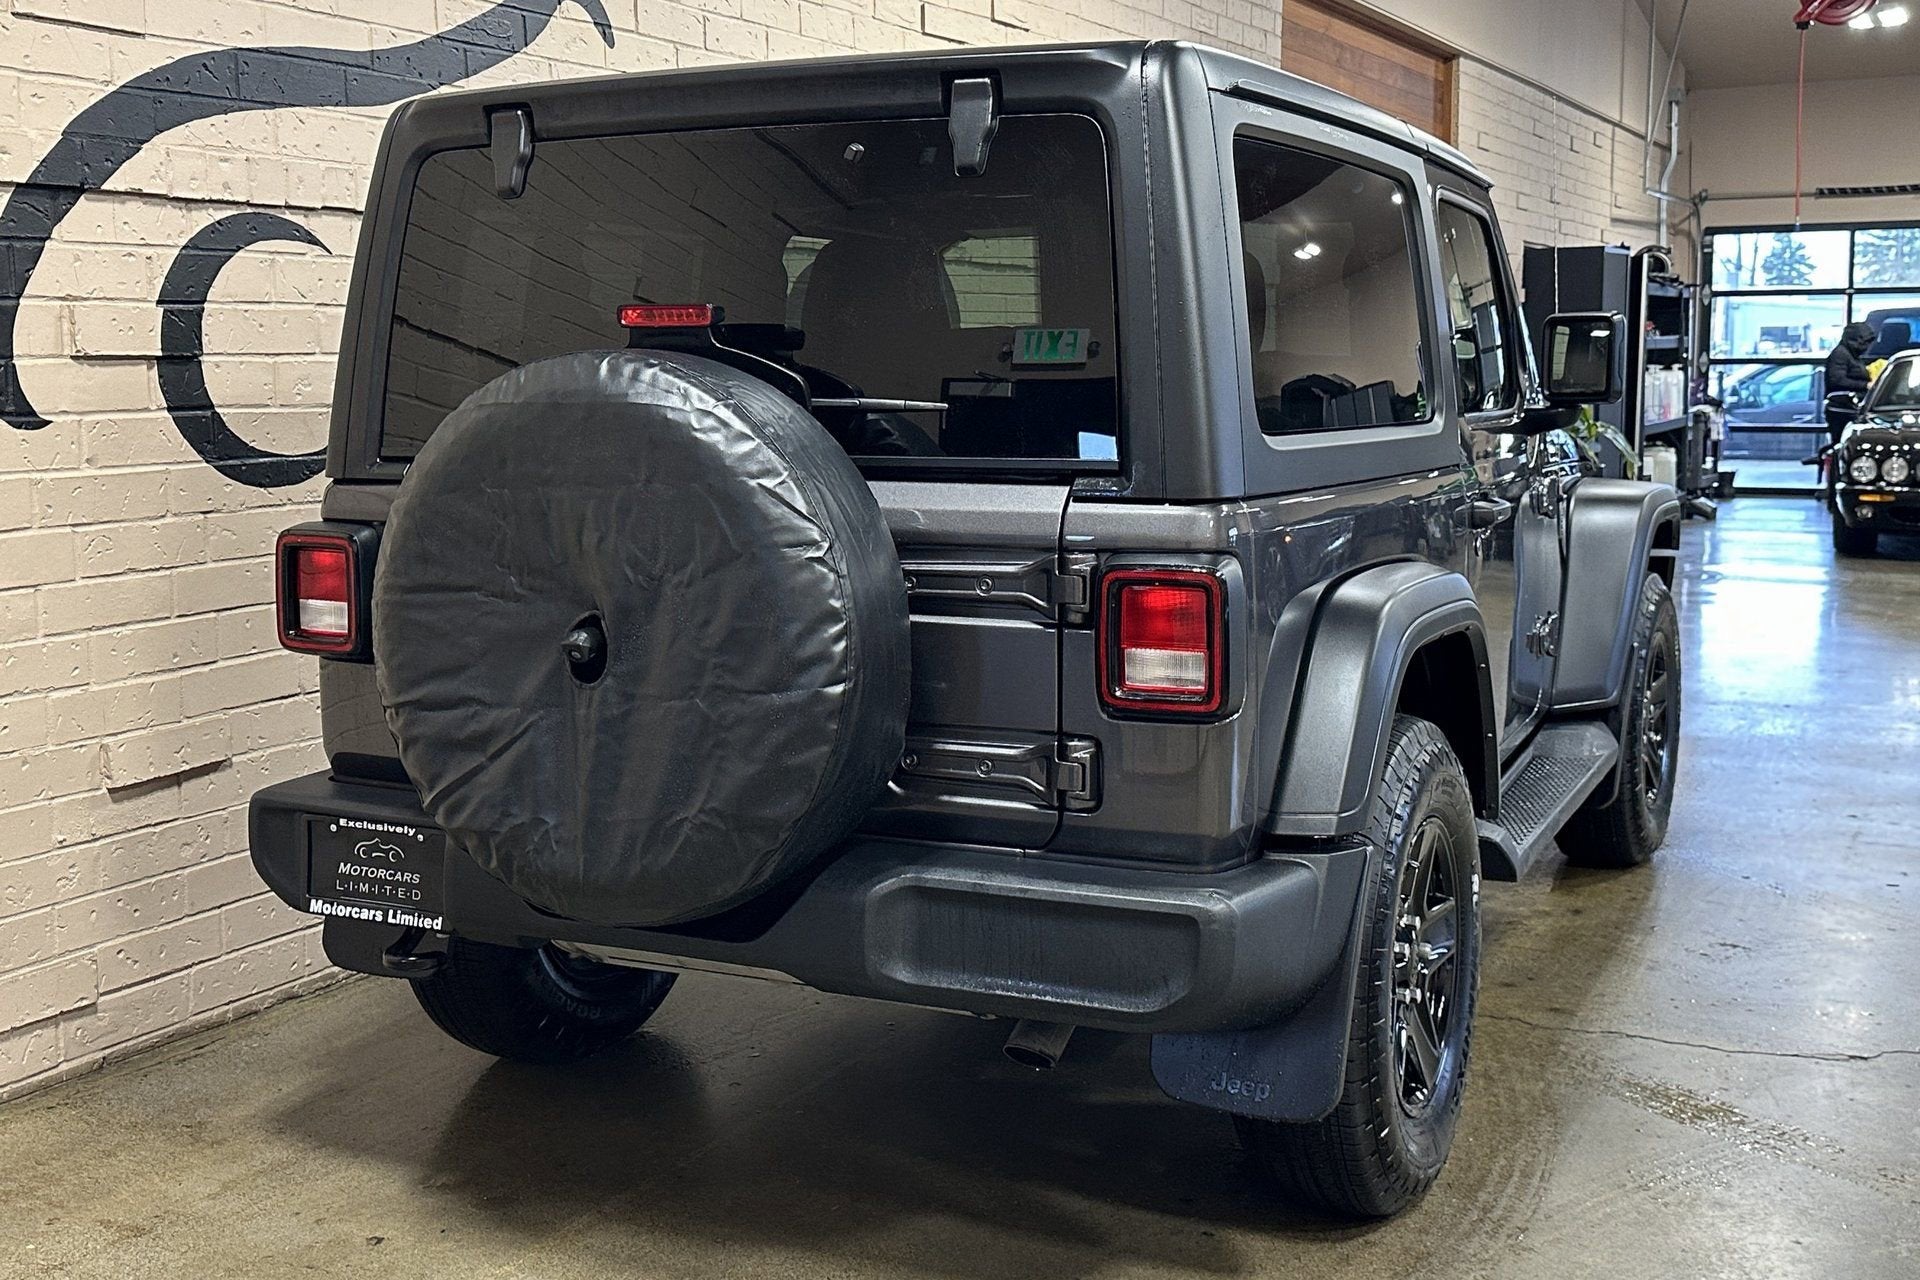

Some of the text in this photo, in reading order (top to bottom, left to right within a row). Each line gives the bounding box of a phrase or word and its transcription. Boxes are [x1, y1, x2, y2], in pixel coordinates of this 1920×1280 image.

[339, 818, 415, 836] Exclusively
[337, 862, 421, 884] MOTORCARS
[309, 899, 443, 930] Motorcars Limited
[1211, 1071, 1270, 1101] Jeep
